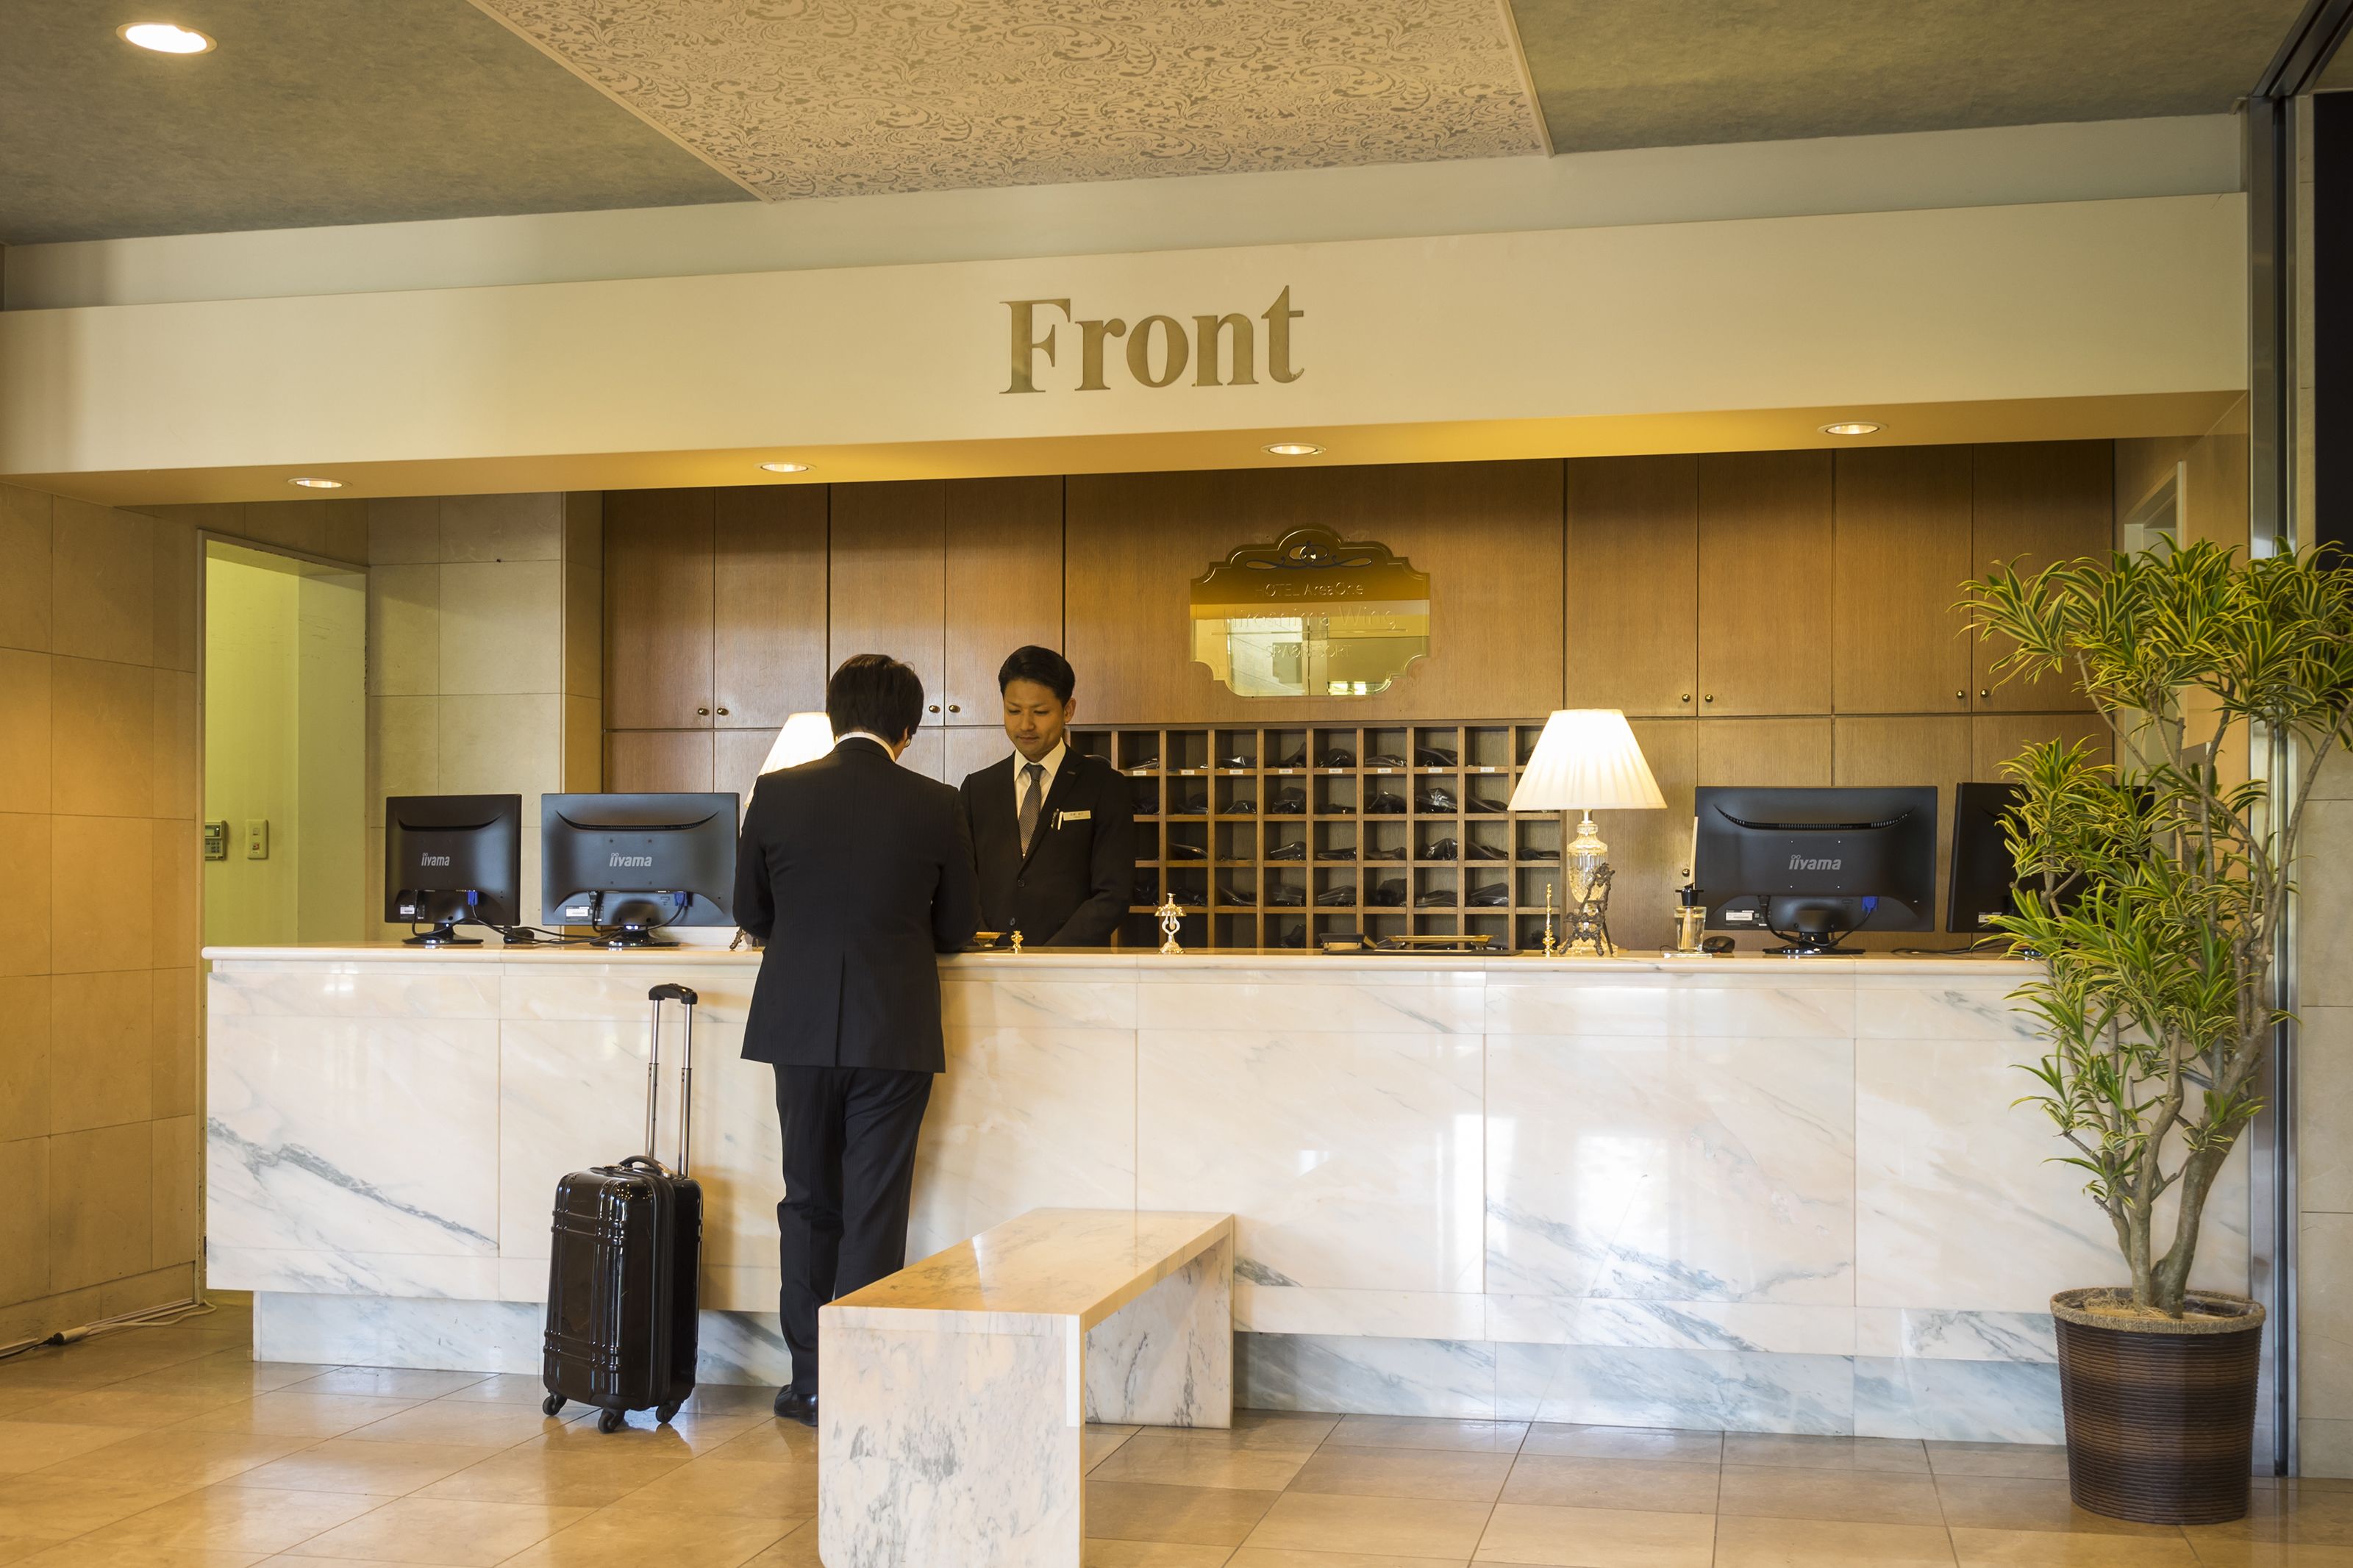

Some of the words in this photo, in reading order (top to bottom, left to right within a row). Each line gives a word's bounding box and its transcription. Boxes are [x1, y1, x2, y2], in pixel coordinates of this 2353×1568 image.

[999, 284, 1305, 395] Front
[1254, 583, 1301, 597] HOTEL
[1338, 605, 1398, 630] Wing
[421, 852, 450, 867] iiyama
[609, 852, 652, 868] iiyama
[1788, 854, 1841, 871] iiyama
